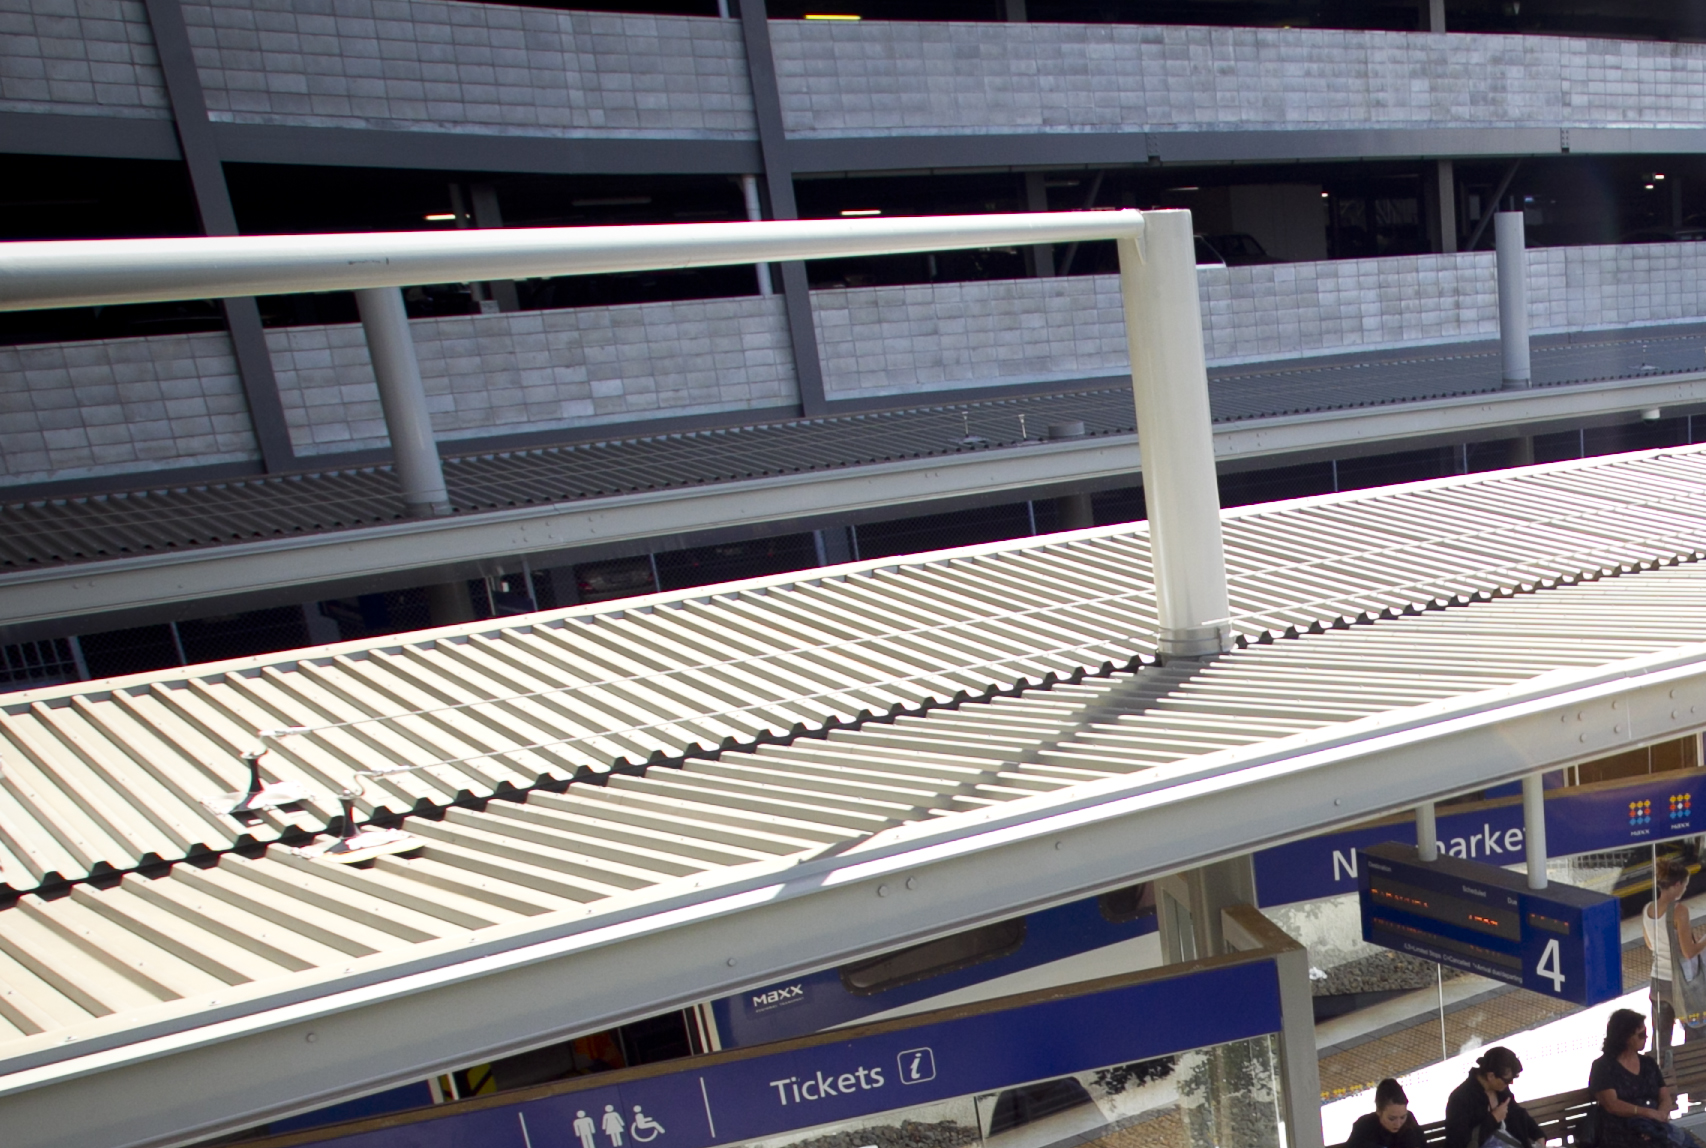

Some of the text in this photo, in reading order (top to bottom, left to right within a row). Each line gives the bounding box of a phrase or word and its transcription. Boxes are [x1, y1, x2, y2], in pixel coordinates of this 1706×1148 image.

[1507, 896, 1518, 906] Due
[1536, 938, 1566, 992] 4
[769, 1066, 885, 1106] Tickets
